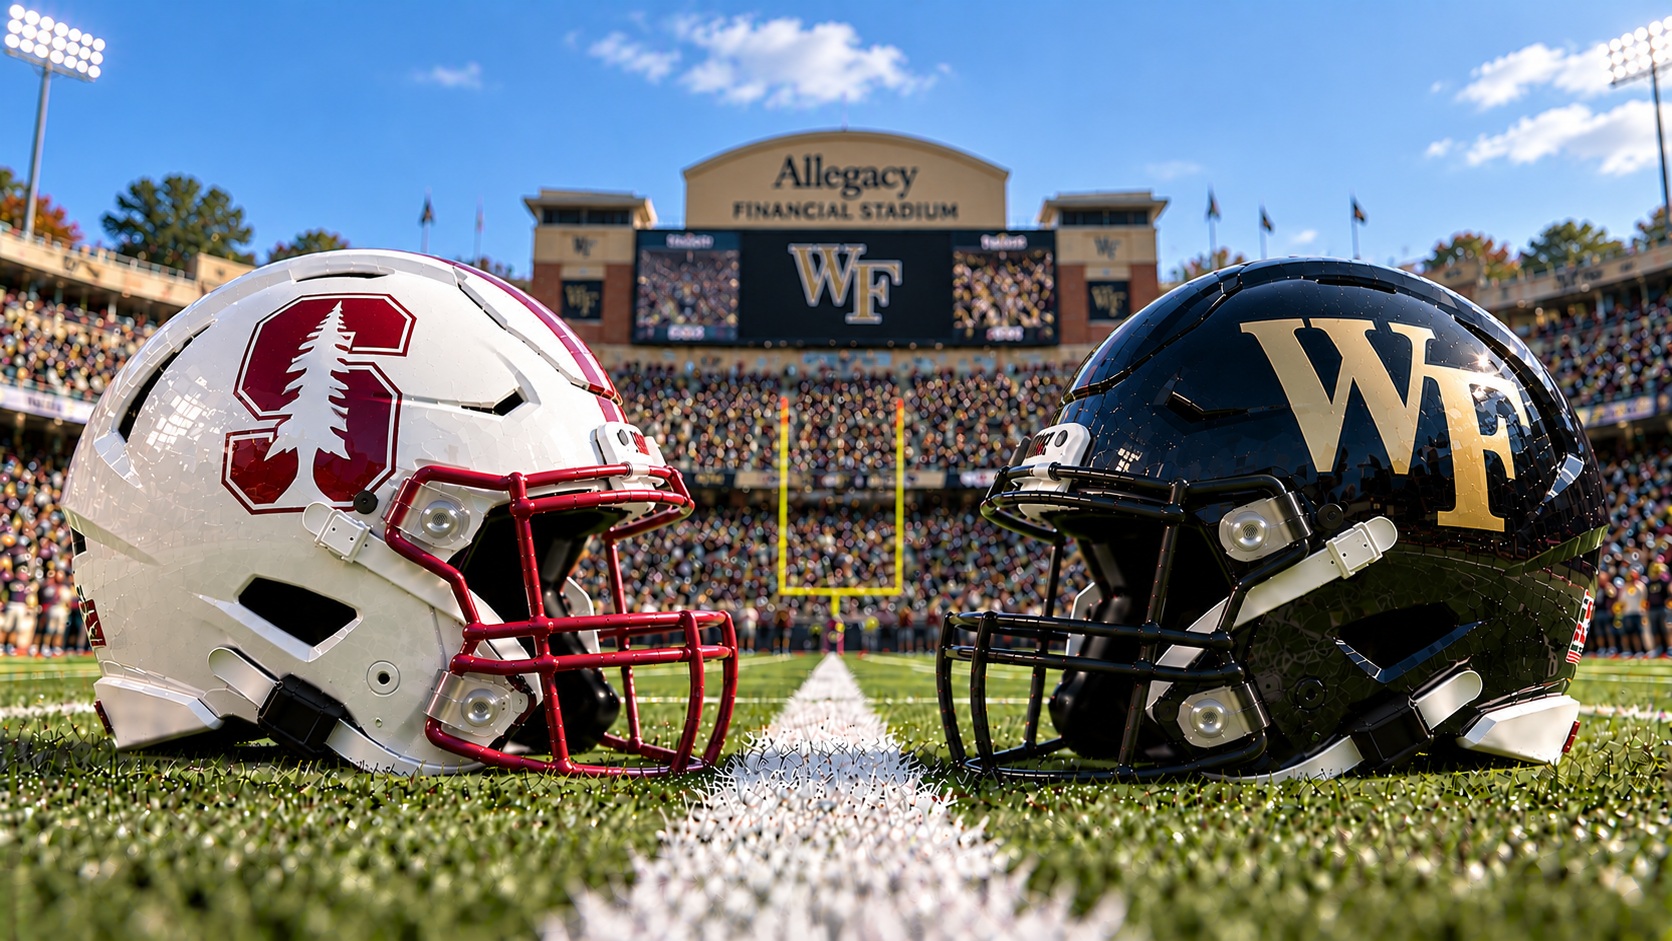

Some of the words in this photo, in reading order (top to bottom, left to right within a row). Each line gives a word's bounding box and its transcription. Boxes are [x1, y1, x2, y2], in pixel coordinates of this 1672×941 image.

[773, 153, 919, 200] Allegacy
[732, 201, 854, 221] FINANCIAL
[859, 201, 959, 220] STADIUM
[788, 243, 903, 325] WF
[1240, 318, 1531, 532] WF
